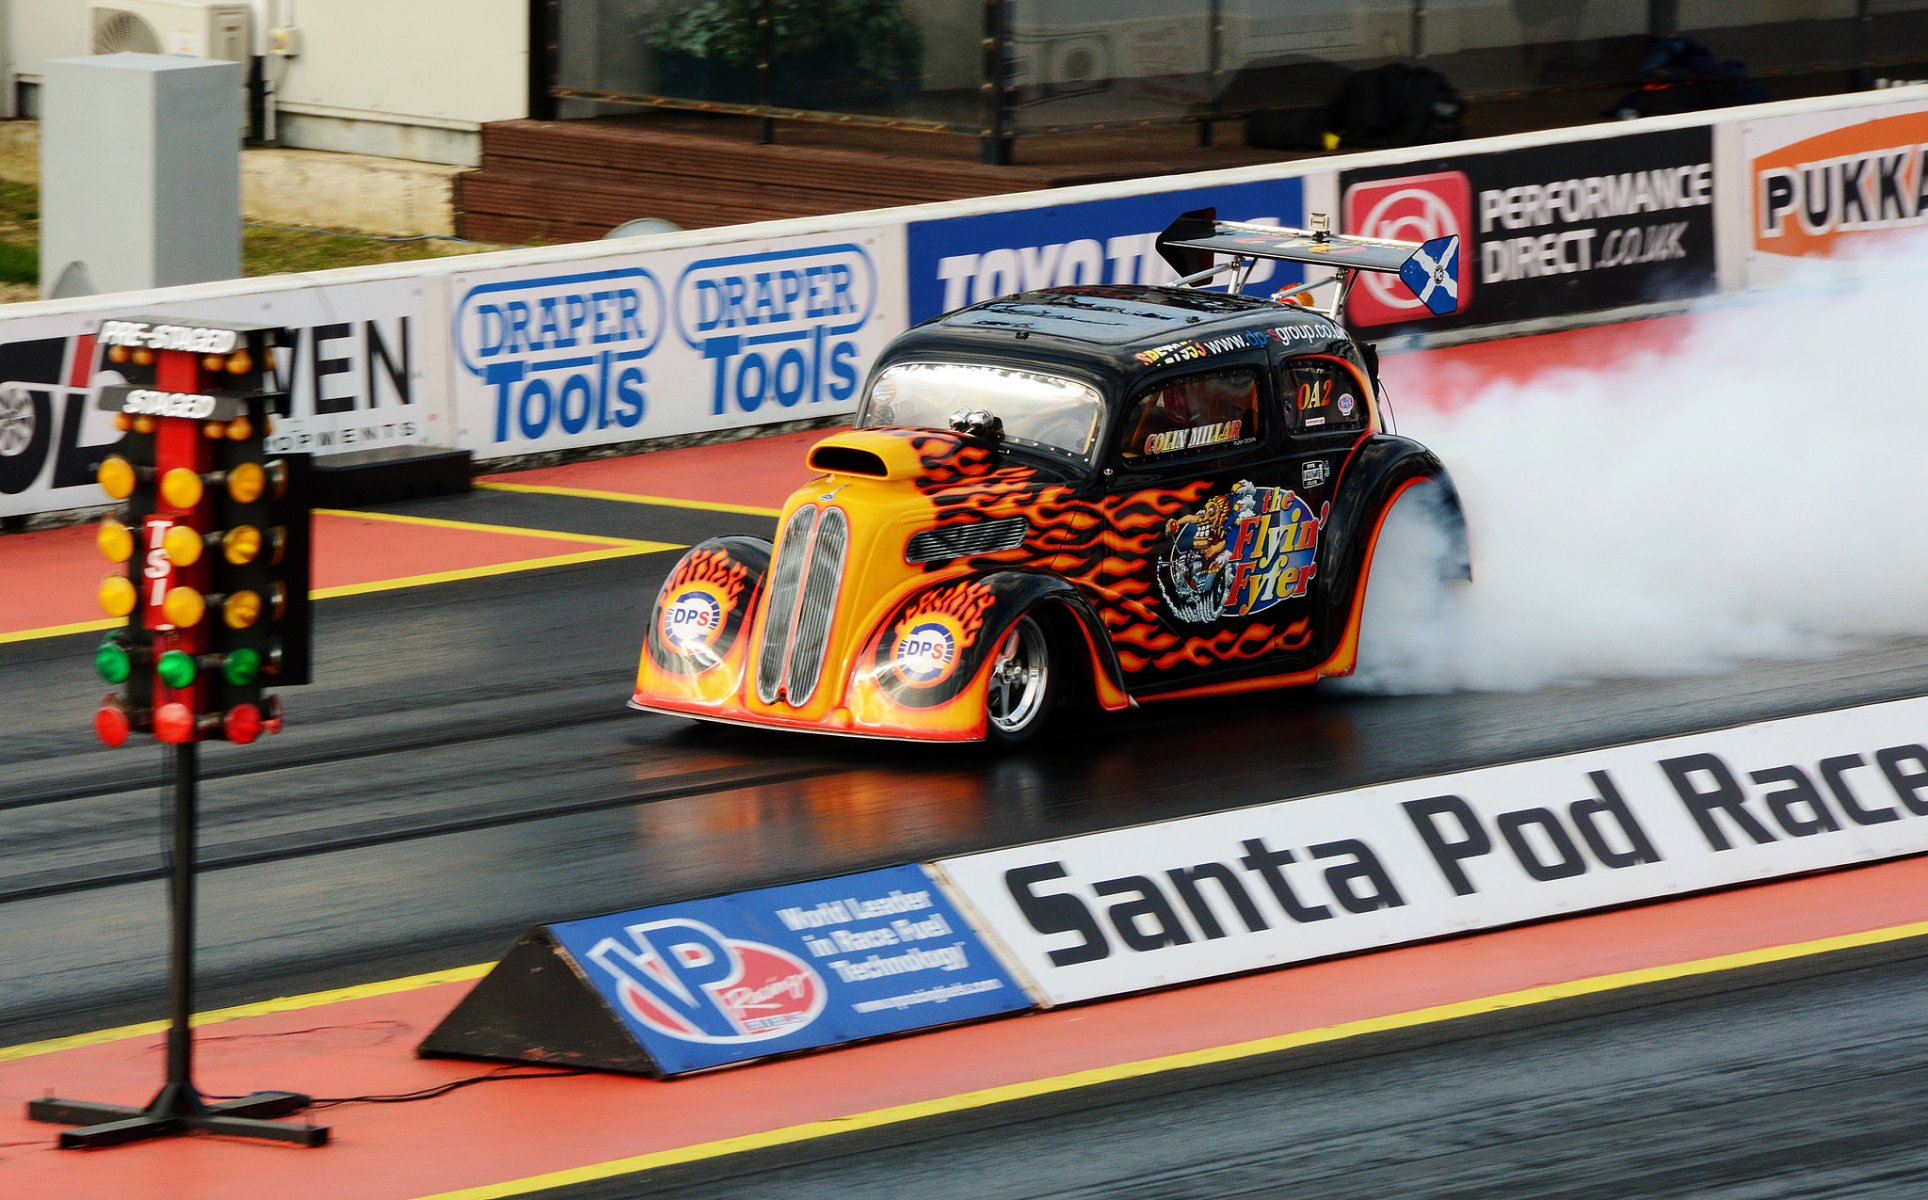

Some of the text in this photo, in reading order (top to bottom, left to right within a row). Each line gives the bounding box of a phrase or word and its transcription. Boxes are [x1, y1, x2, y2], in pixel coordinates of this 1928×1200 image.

[1479, 163, 1712, 233] PERFORMANCE
[936, 239, 1103, 314] TOYO
[692, 263, 857, 333] DRAPER
[97, 320, 237, 354] PRE-STAGED
[474, 287, 645, 358] DRAPER
[702, 325, 859, 415] Tools
[122, 389, 217, 419] STAGED
[485, 351, 647, 443] Tools
[1144, 420, 1242, 455] COLIN MILLAR
[1262, 486, 1296, 513] the
[1223, 554, 1318, 617] Fyfer
[673, 608, 709, 627] DPS
[906, 639, 945, 660] DPS
[1004, 744, 1928, 968] Santa Pod Race
[775, 890, 934, 931] World Leader
[801, 913, 953, 957] in Race Fuel
[827, 945, 969, 983] Technology
[722, 970, 812, 1009] Racing
